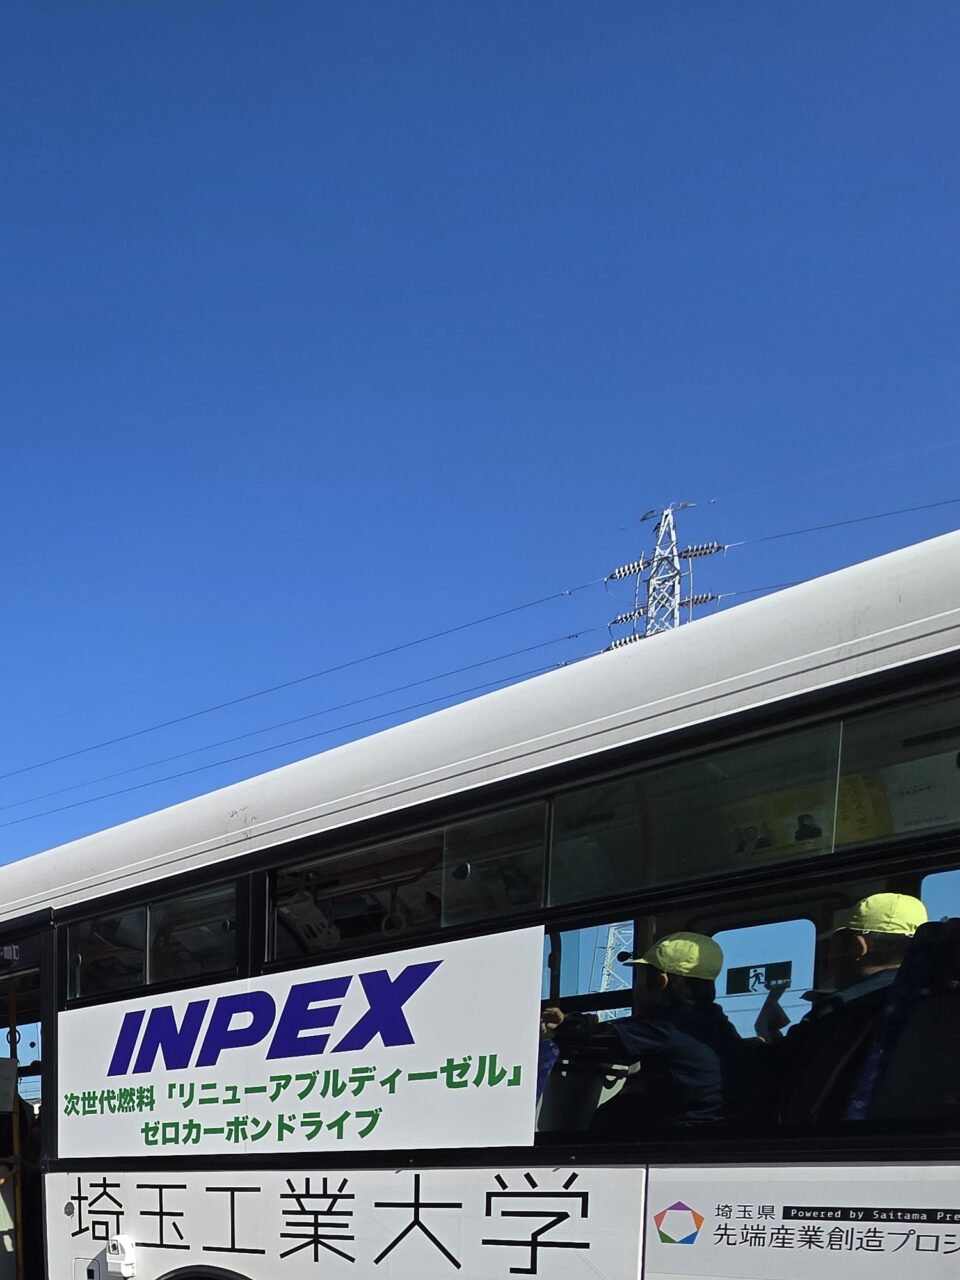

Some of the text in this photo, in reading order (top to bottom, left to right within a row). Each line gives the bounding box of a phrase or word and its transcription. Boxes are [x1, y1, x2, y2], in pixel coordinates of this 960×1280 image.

[107, 959, 445, 1077] INPEX
[140, 1107, 383, 1146] ゼロカーボンドライブ
[70, 1171, 591, 1275] 埼玉工業大学
[714, 1203, 776, 1221] 埼玉県
[790, 1208, 960, 1221] Powered by Saitama Pre
